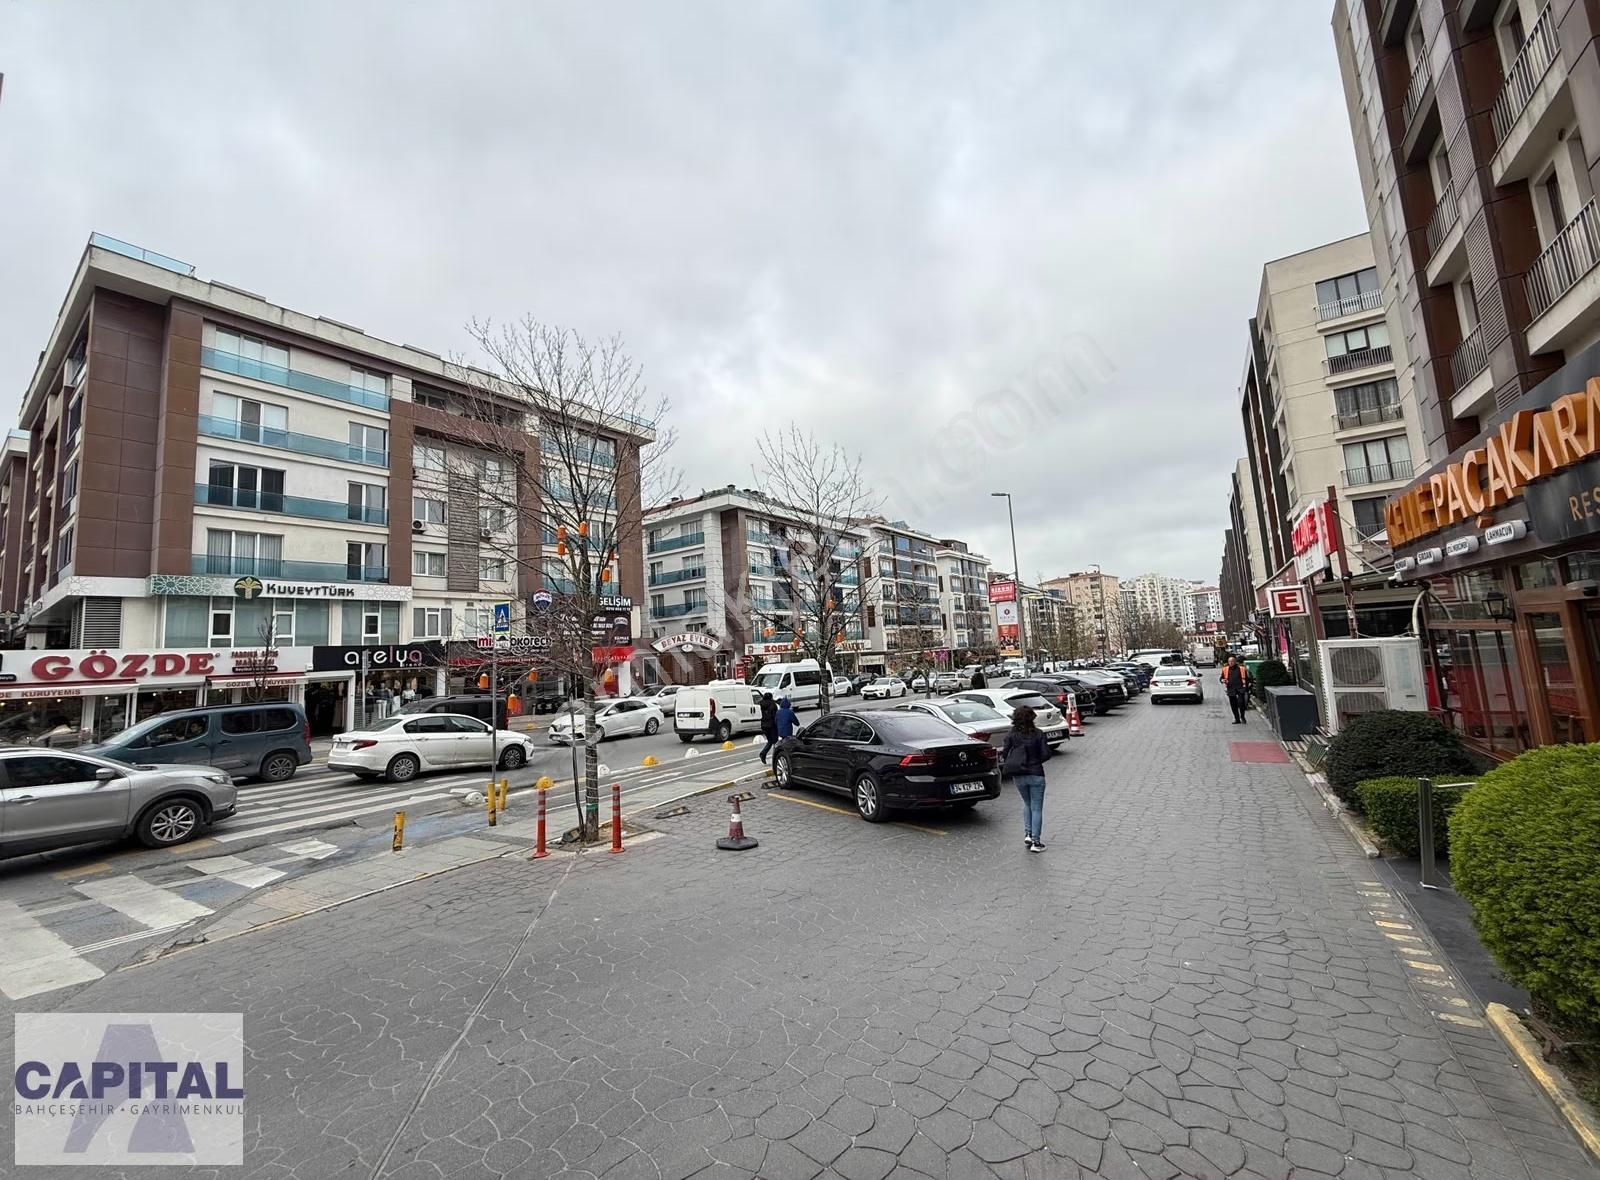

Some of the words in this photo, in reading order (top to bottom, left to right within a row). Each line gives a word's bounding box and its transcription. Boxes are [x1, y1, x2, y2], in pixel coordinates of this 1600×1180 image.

[1278, 592, 1300, 612] E
[661, 634, 687, 649] BEYAZ
[689, 633, 714, 647] EVLER
[31, 650, 215, 680] GÖZDE
